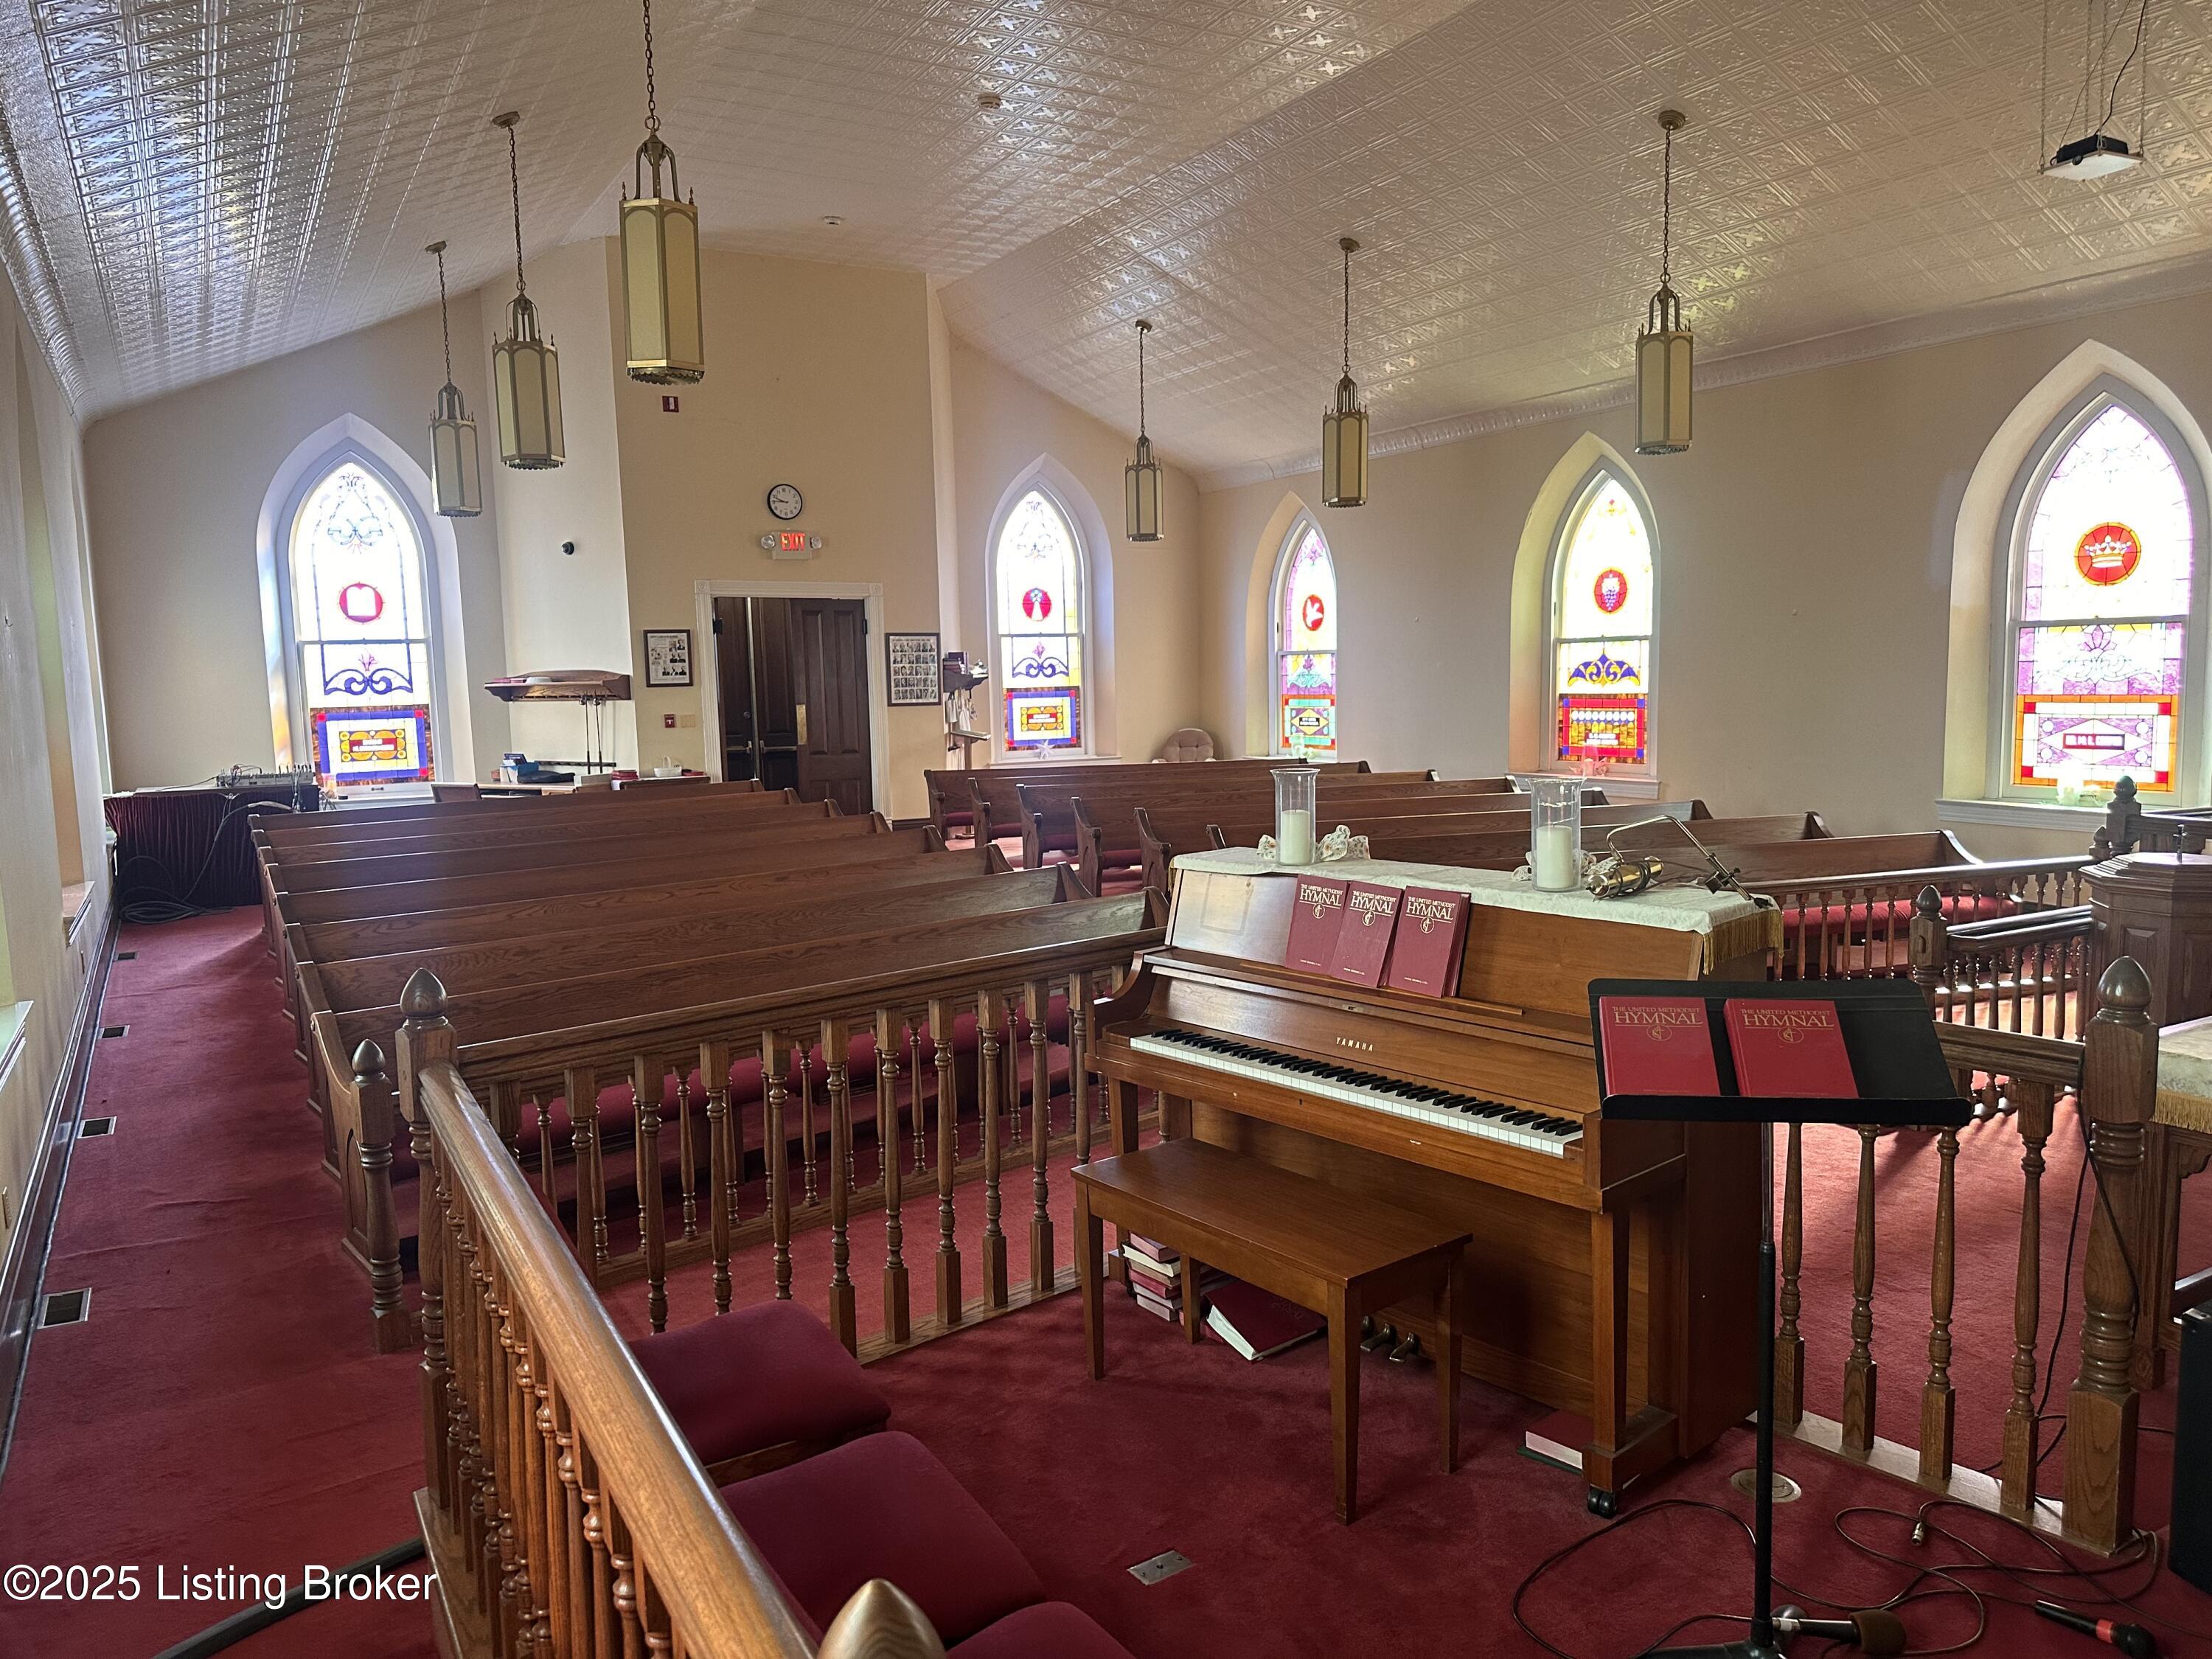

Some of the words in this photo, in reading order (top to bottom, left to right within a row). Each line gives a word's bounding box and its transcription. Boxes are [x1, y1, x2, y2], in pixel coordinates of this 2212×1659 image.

[781, 533, 805, 552] EXIT
[1300, 888, 1342, 906] HYMNAL
[1322, 887, 1343, 896] METHODIST
[1374, 894, 1397, 903] METHODIST
[1350, 895, 1394, 914] HYMNAL
[1406, 901, 1454, 921] HYMNAL
[1432, 900, 1456, 908] METHODIST
[1614, 1012, 1703, 1024] HYMNAL
[1743, 1014, 1835, 1027] HYMNAL
[1336, 1036, 1374, 1051] YAMAHA
